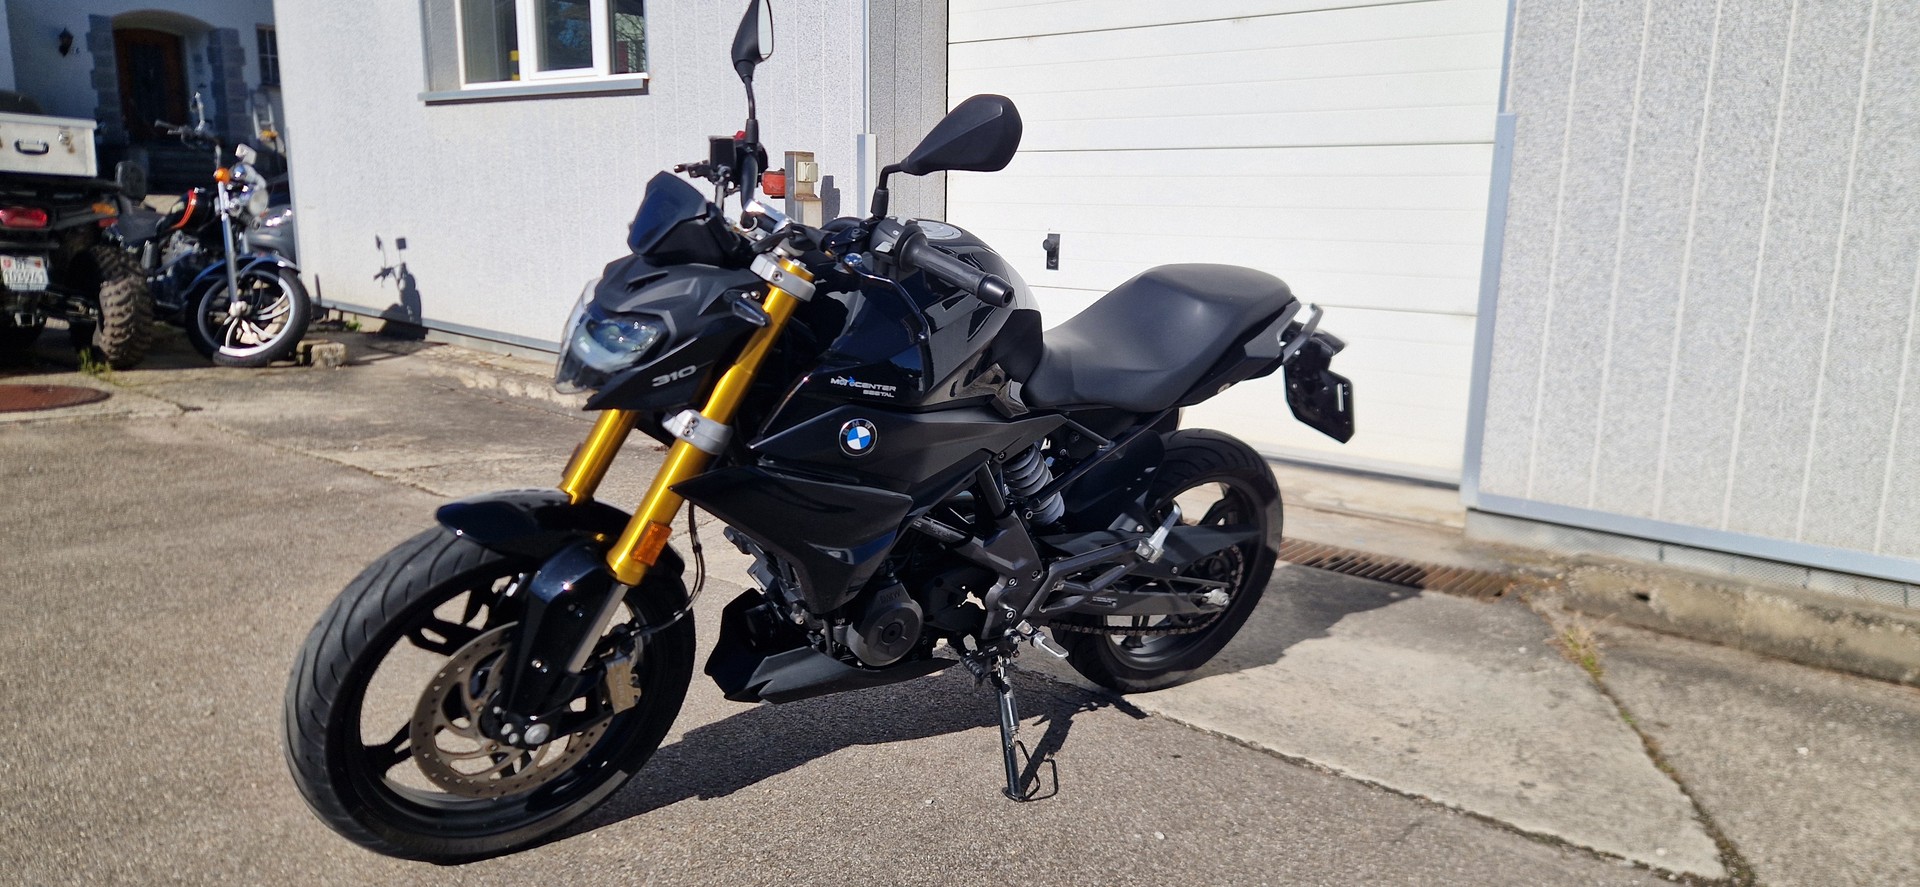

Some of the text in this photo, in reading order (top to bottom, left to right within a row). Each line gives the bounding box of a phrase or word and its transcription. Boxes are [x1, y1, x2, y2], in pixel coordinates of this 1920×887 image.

[652, 365, 697, 387] 310
[842, 420, 873, 436] BMW
[879, 589, 901, 604] BMW
